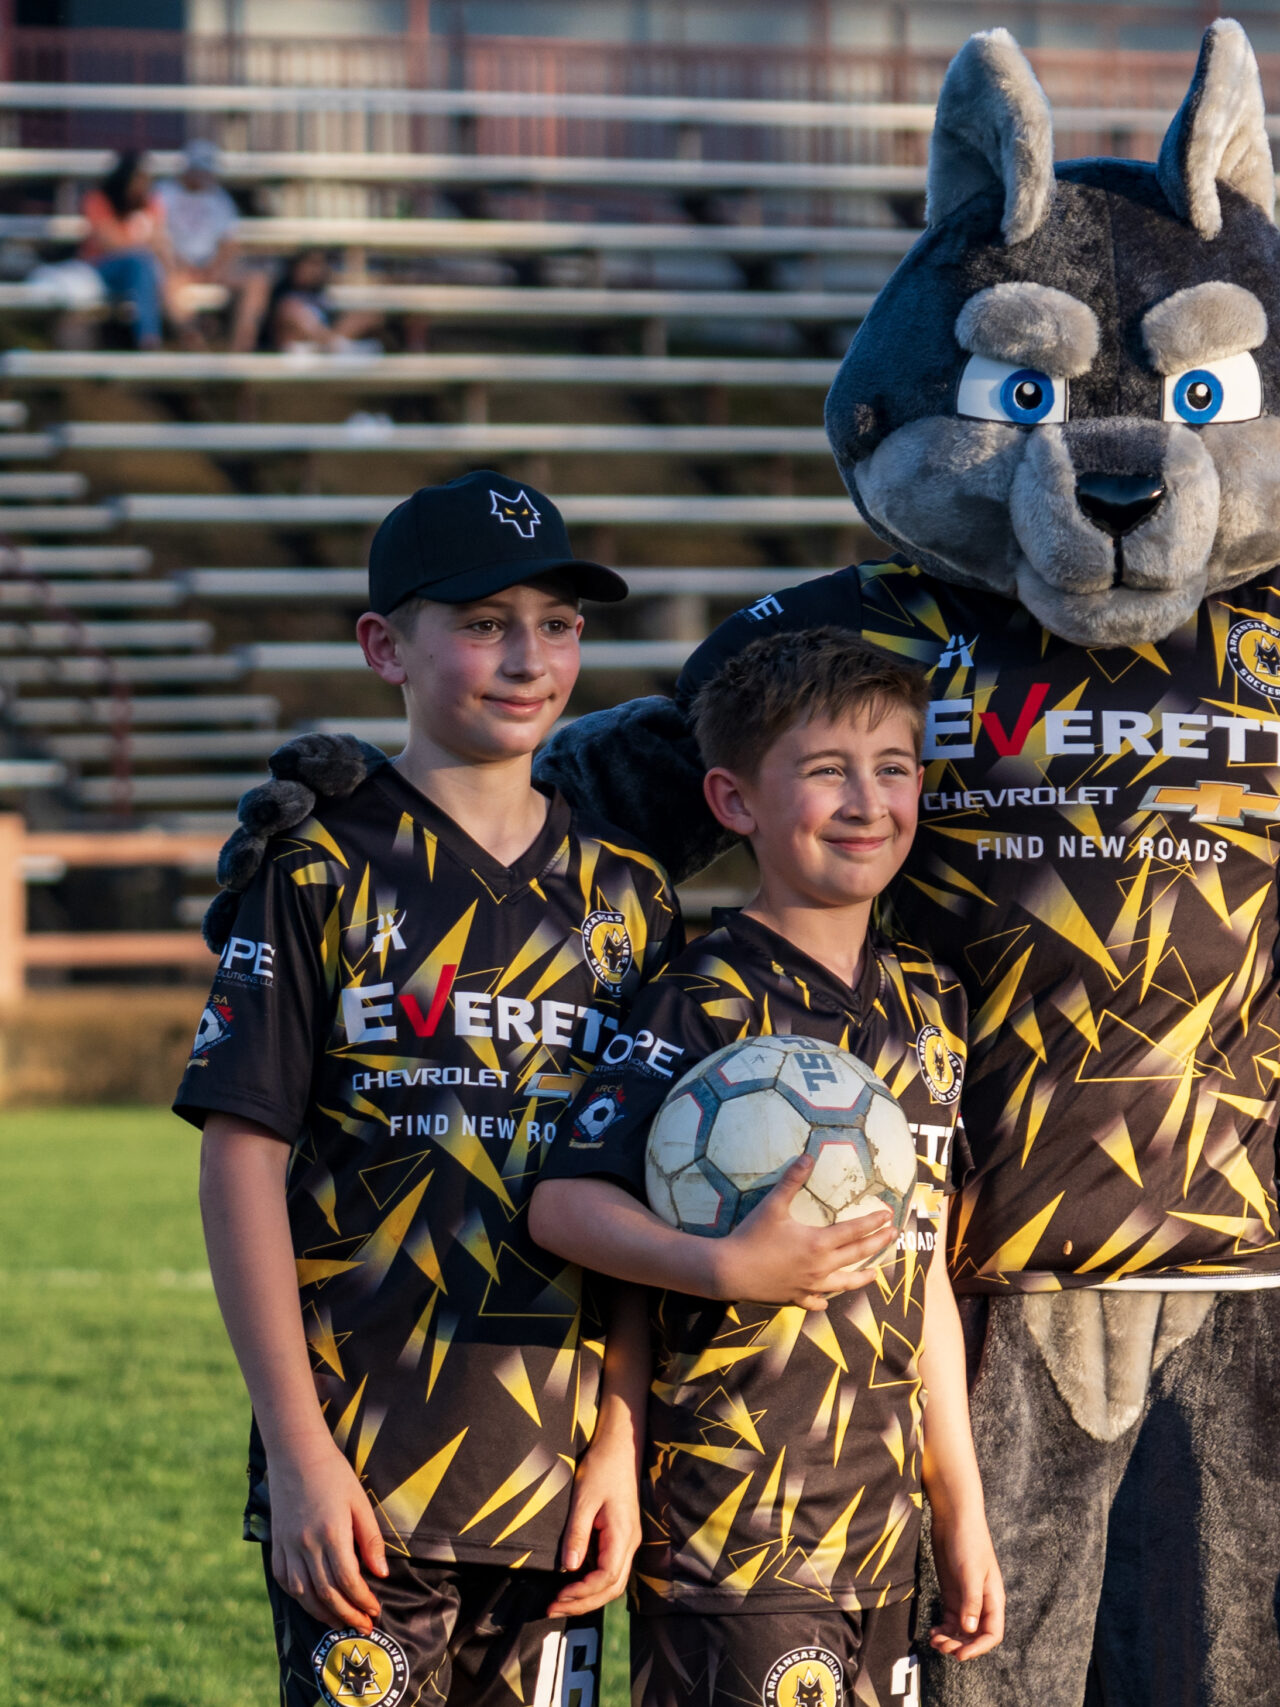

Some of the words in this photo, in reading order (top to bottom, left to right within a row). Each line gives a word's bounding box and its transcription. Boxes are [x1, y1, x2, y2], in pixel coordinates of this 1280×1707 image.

[1229, 622, 1268, 653] ARKANSAS
[923, 786, 1118, 812] CHEVROLET
[976, 836, 1045, 860] FIND
[1058, 836, 1126, 859] NEW
[1138, 836, 1228, 863] ROADS
[220, 936, 276, 979] PE
[216, 968, 258, 984] OLUTIONS
[602, 1029, 685, 1078] OPE
[353, 1067, 509, 1091] CHEVROLET
[389, 1114, 449, 1137] FIND
[461, 1114, 516, 1140] NEW
[314, 1628, 366, 1675] ARKANSA
[369, 1631, 405, 1672] WOLVES
[766, 1650, 817, 1699] ARKANSAS
